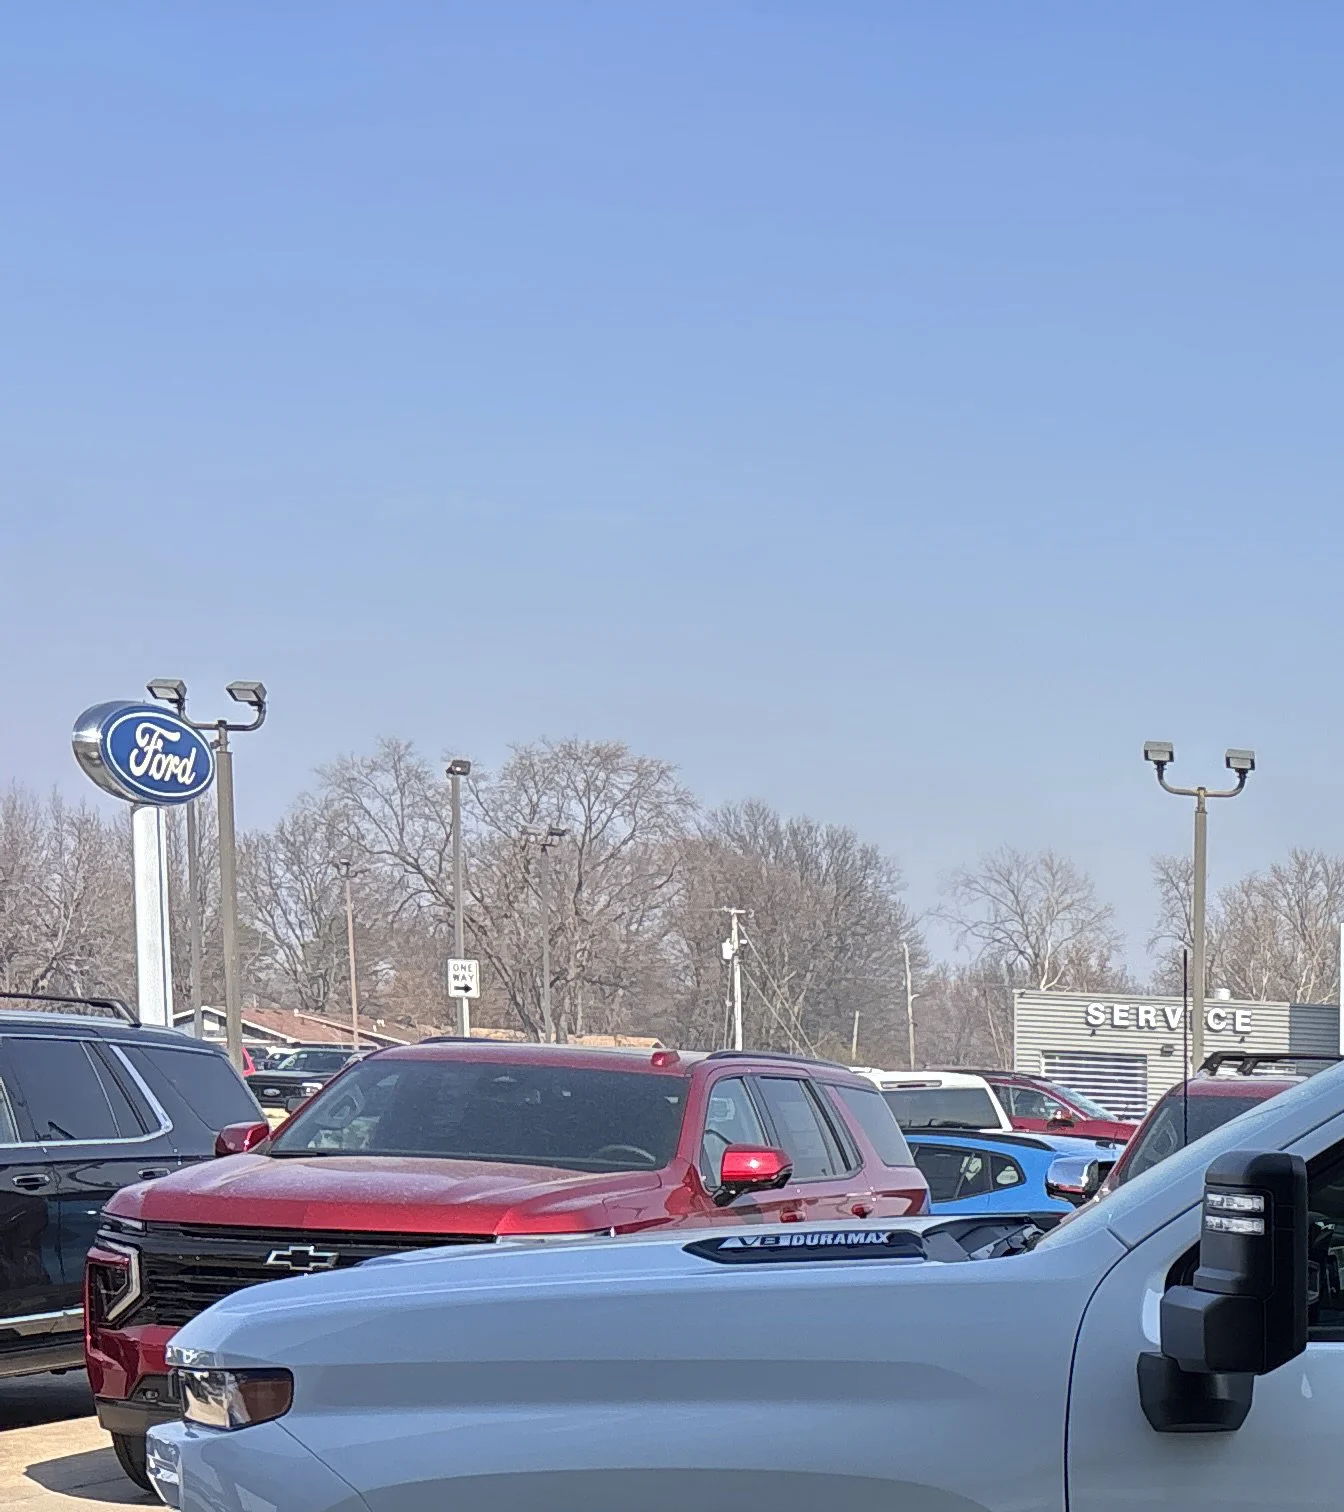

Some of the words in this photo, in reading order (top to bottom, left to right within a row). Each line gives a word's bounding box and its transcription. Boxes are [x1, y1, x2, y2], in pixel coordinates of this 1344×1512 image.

[129, 722, 197, 785] Ford
[452, 963, 474, 973] ONE
[452, 973, 475, 982] WAY
[1085, 1001, 1253, 1034] SERVCE
[789, 1231, 894, 1247] DURAMAX
